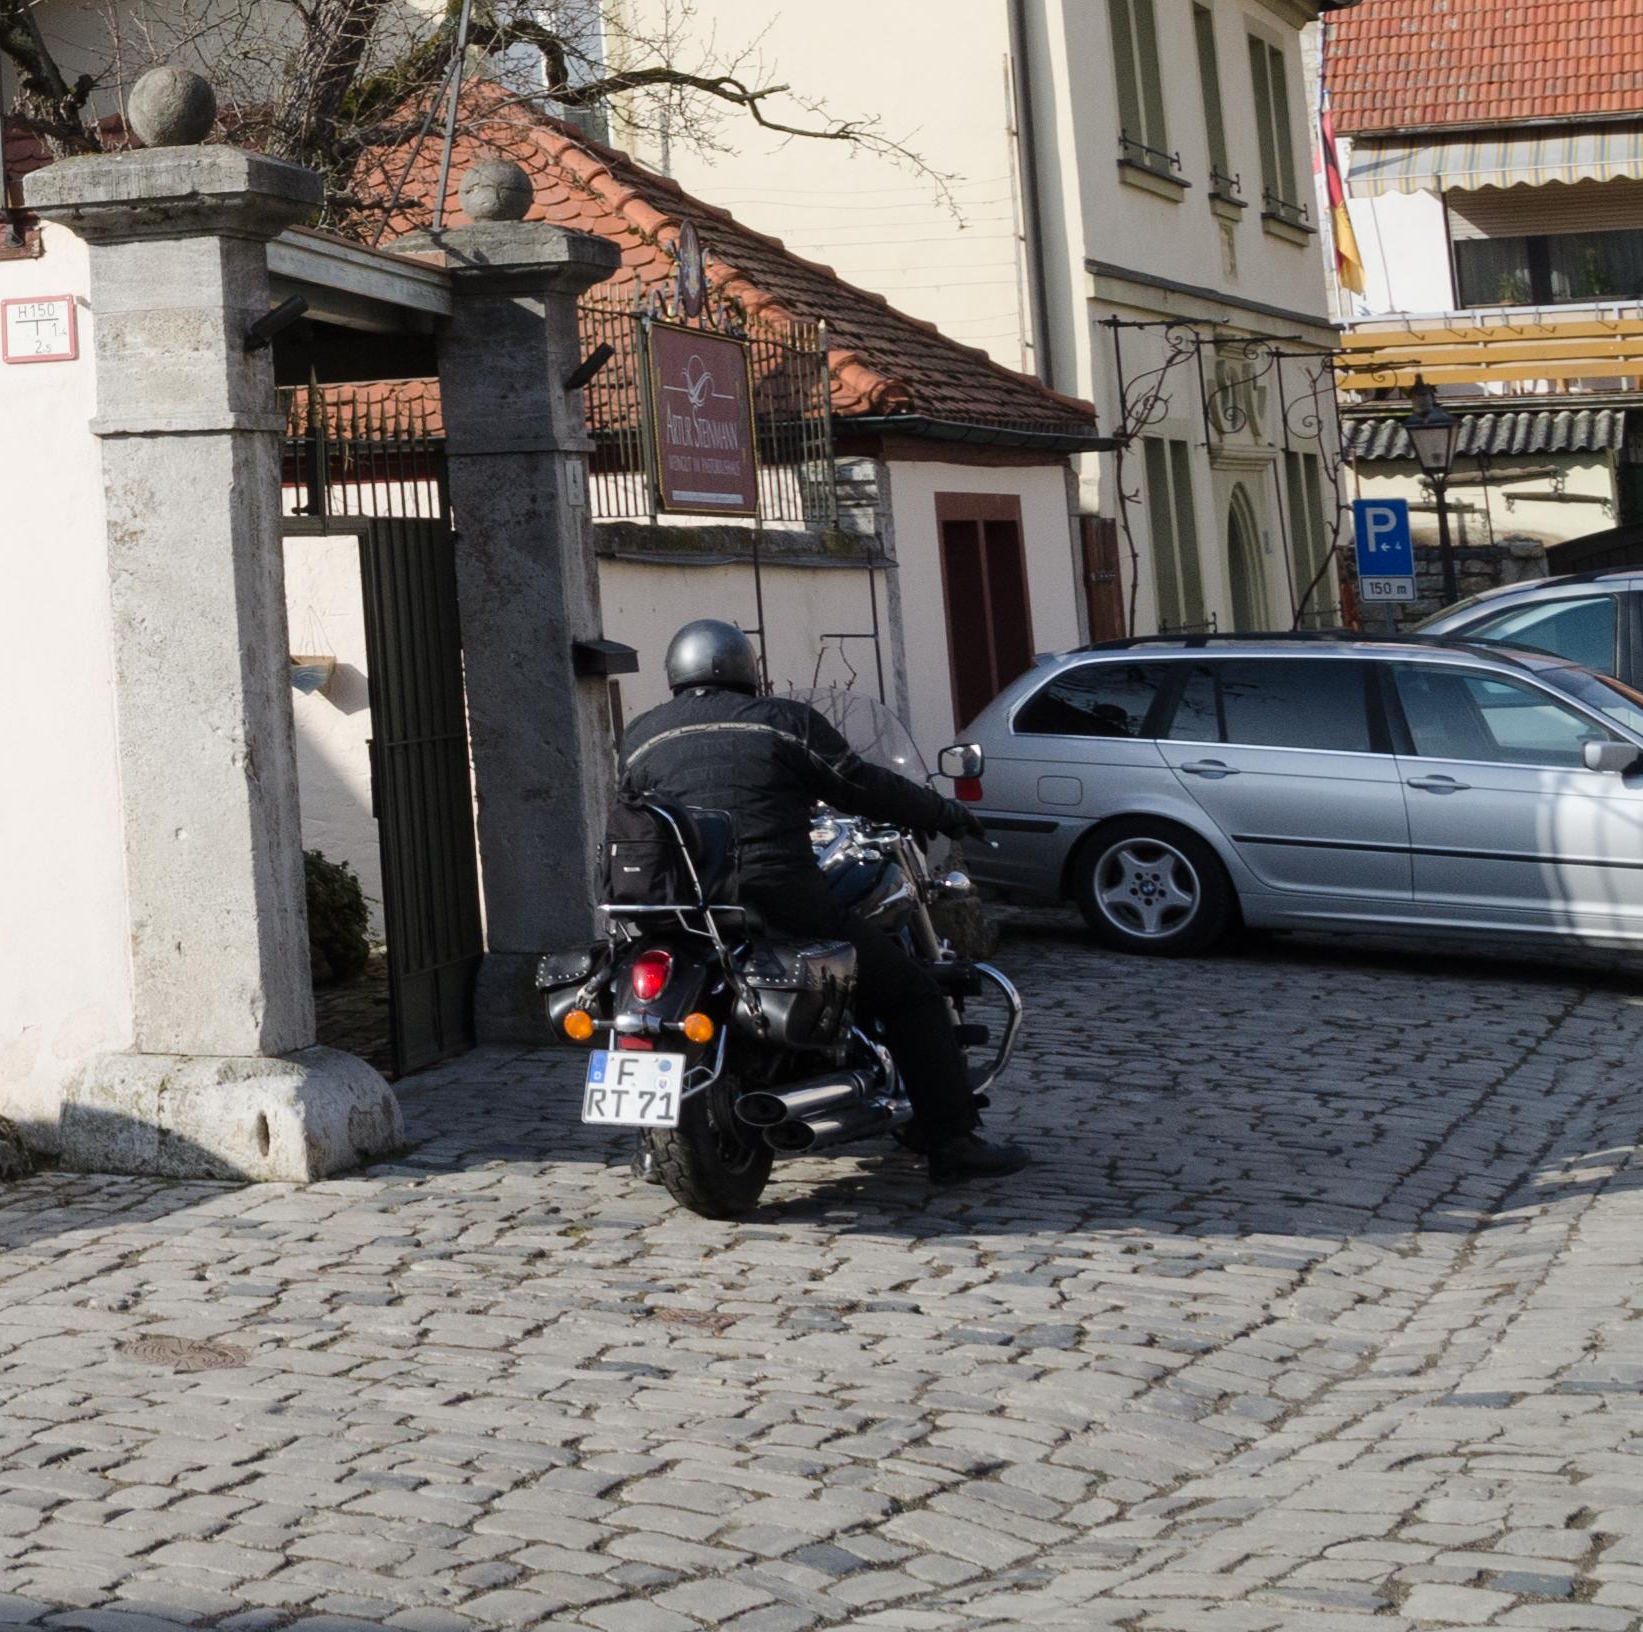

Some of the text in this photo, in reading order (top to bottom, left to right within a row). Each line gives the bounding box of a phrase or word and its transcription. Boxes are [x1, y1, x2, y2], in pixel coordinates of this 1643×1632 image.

[1365, 508, 1397, 552] P
[1369, 582, 1407, 595] 150 m
[617, 1058, 639, 1086] F
[587, 1088, 674, 1121] RT 71
